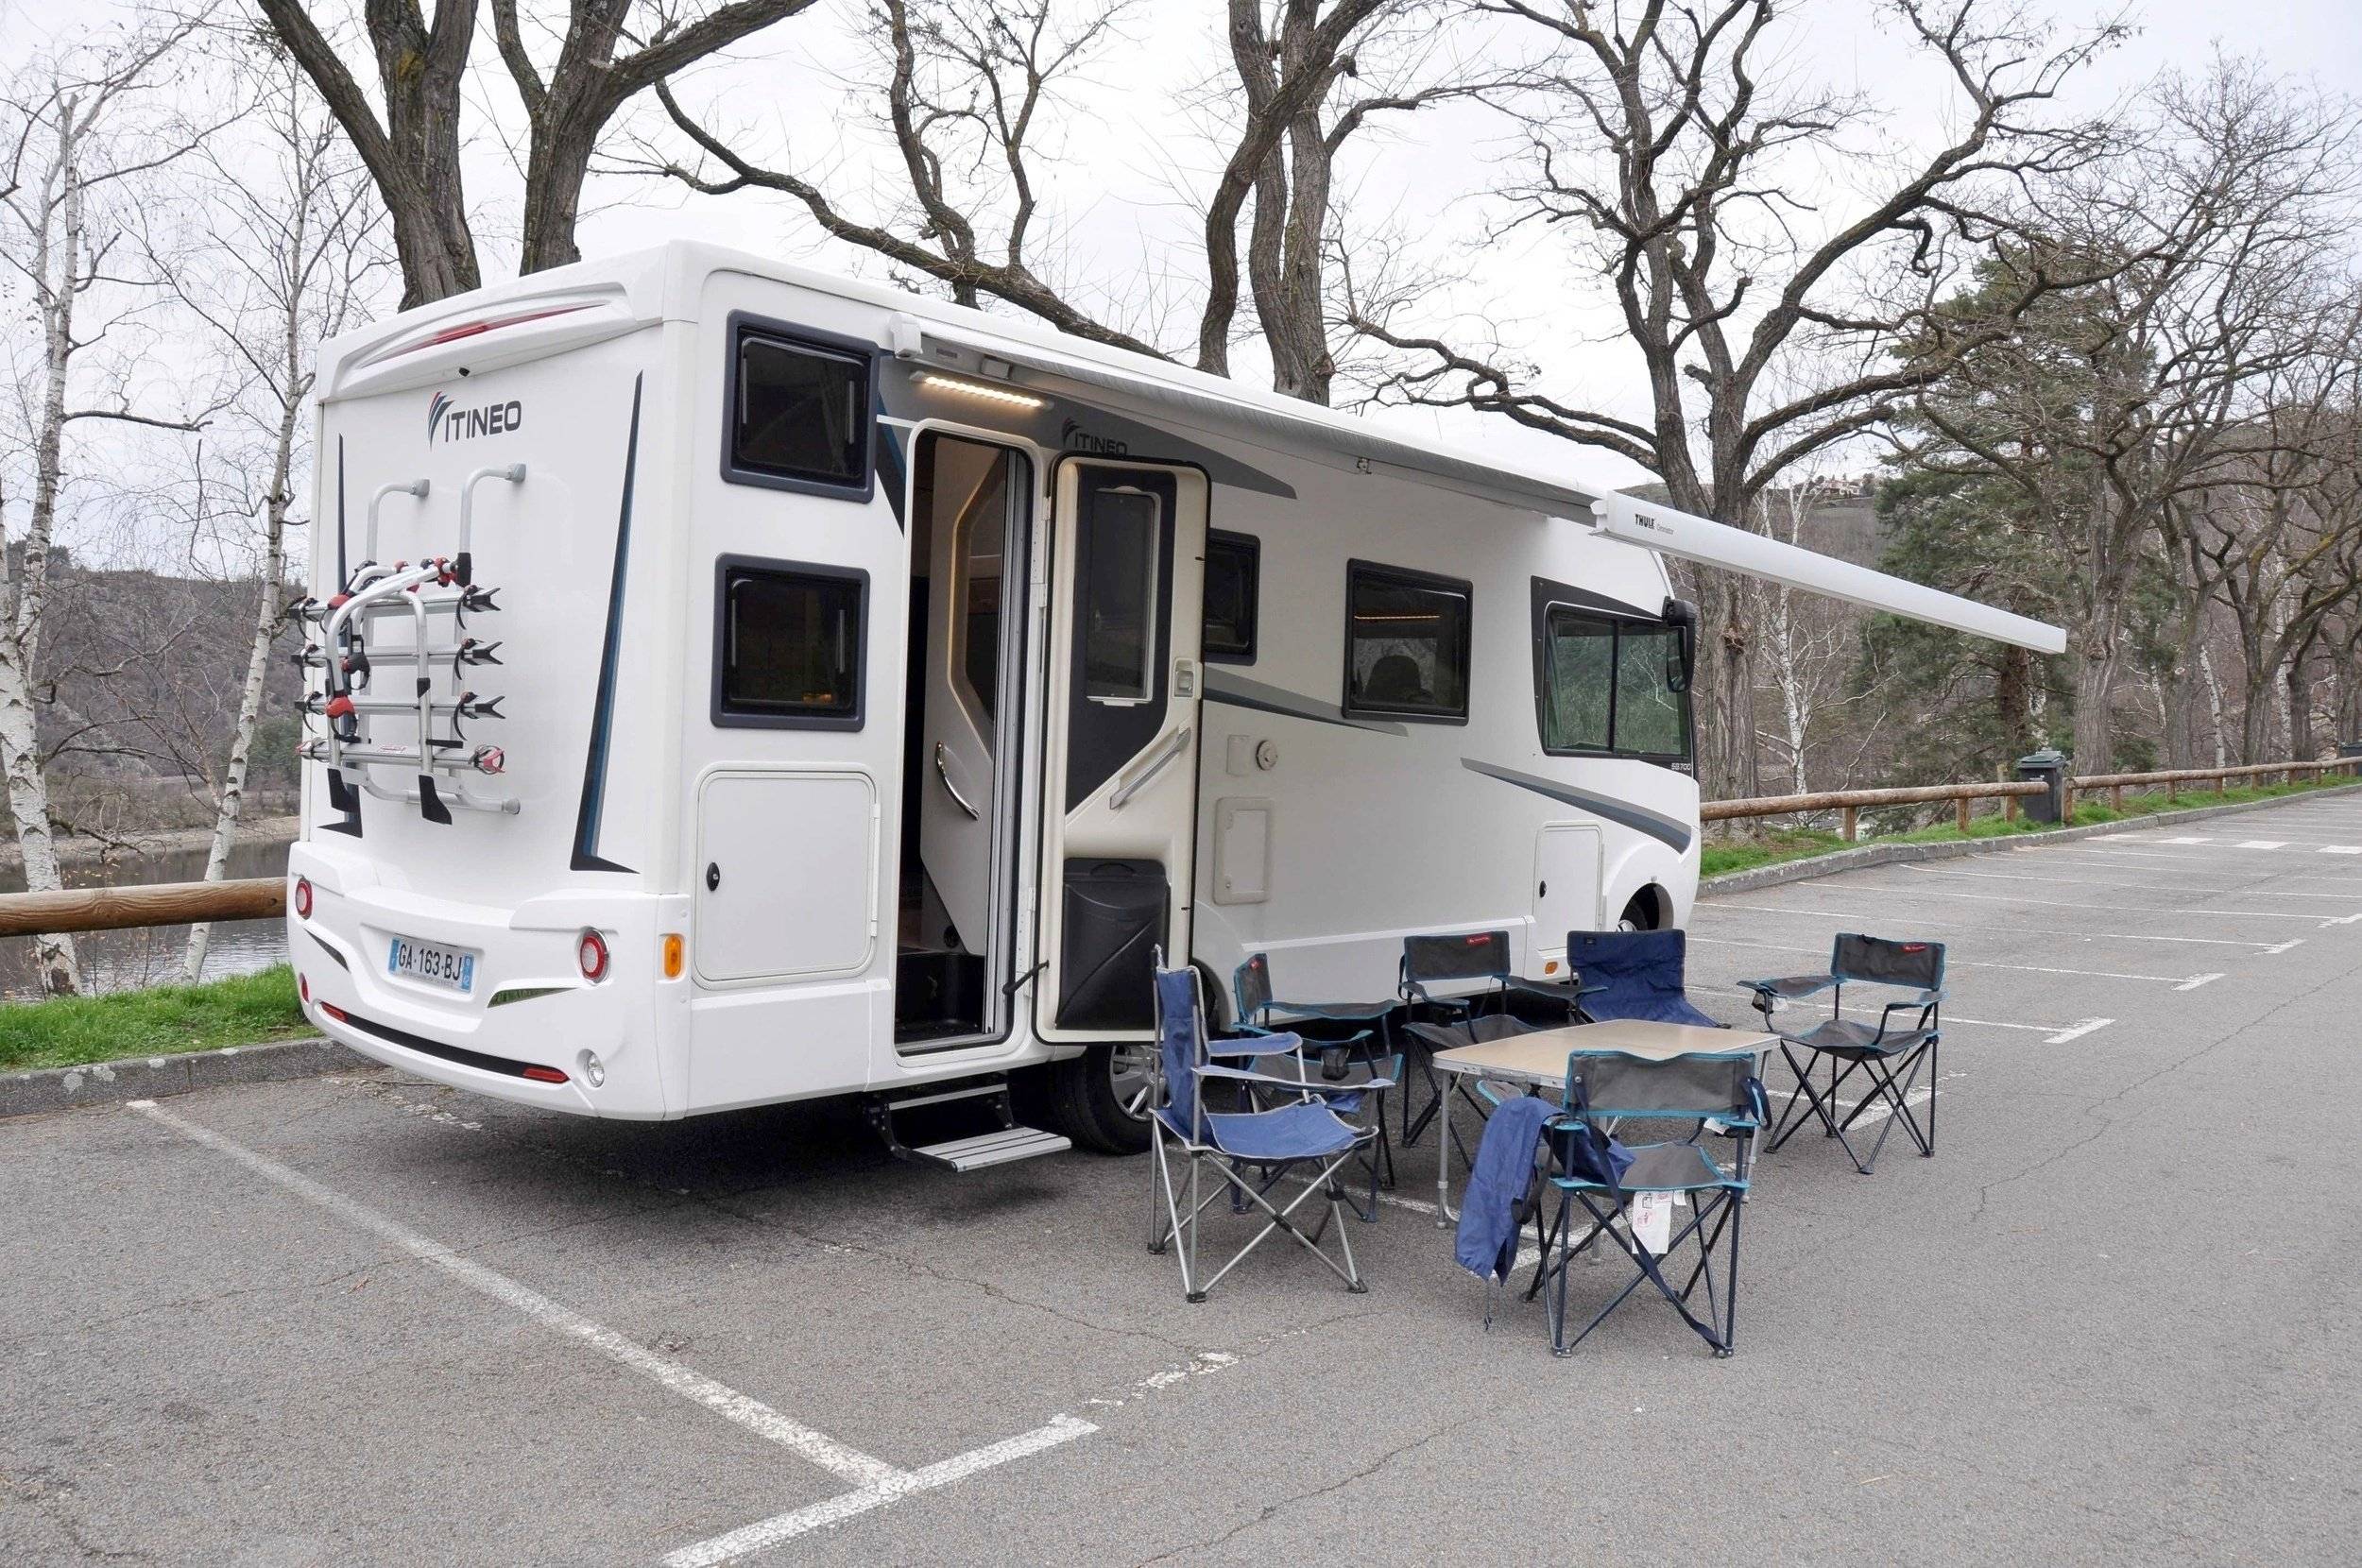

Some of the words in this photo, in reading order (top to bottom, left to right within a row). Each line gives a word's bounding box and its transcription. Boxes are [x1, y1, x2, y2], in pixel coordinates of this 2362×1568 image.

[445, 400, 522, 443] ITINEO
[1074, 431, 1128, 455] ITINEO
[1635, 513, 1655, 530] THULE
